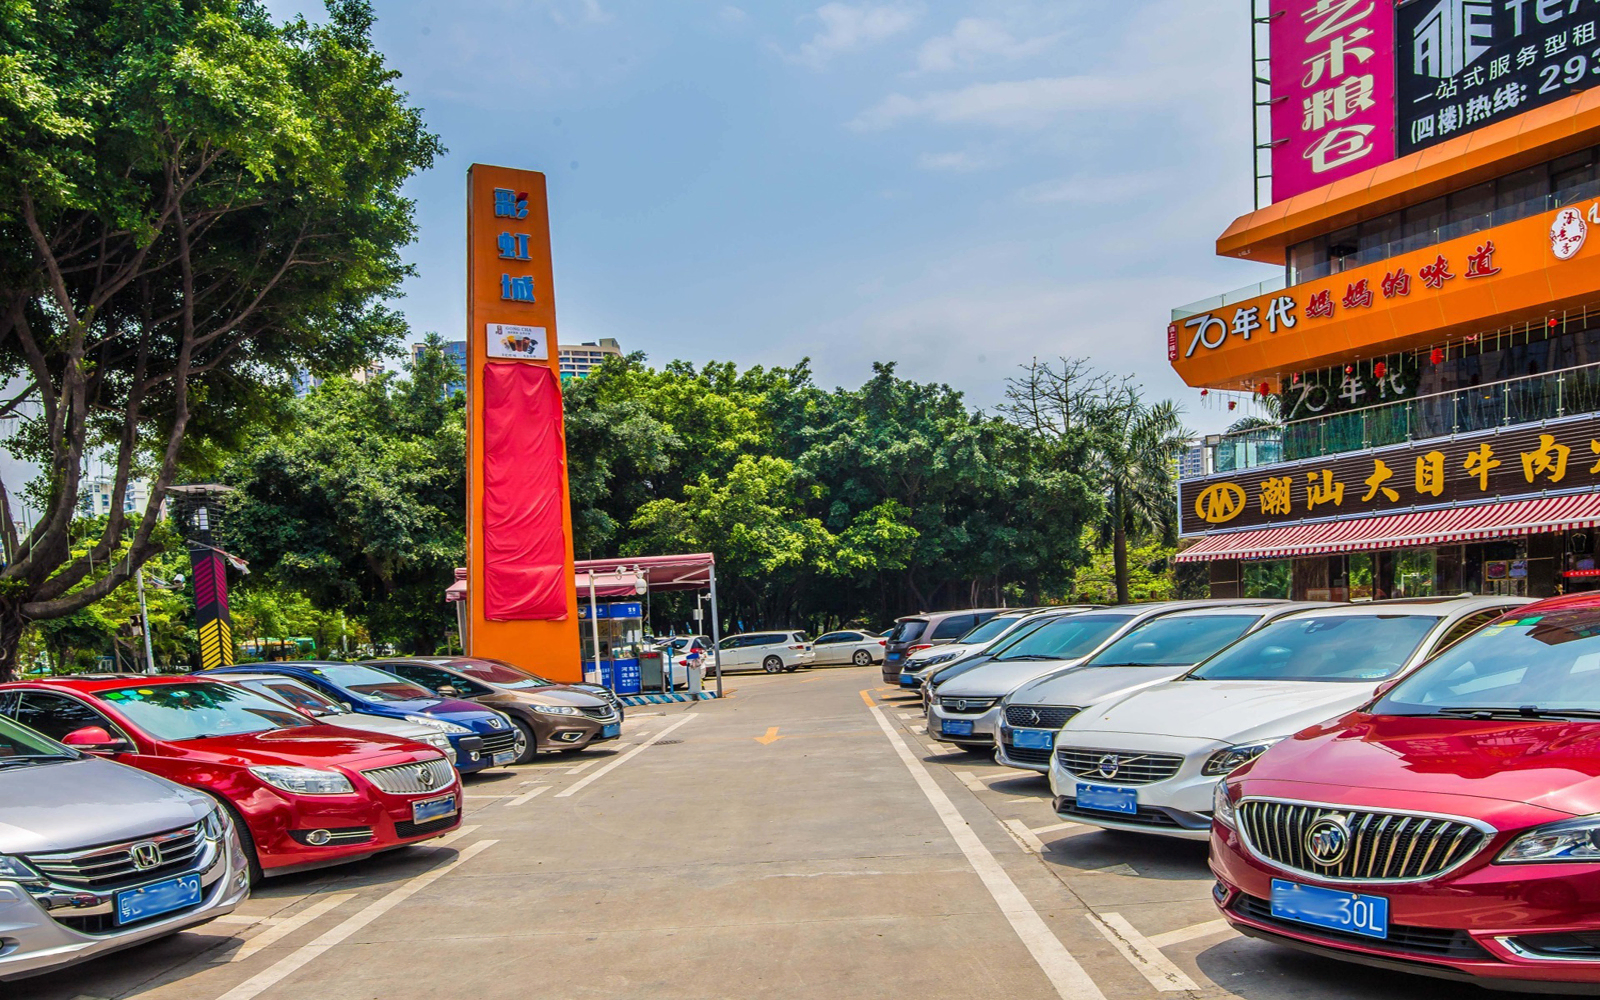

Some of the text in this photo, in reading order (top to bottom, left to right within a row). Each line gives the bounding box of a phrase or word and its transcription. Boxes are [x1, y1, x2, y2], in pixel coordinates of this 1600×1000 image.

[1301, 0, 1376, 174] 艺术粮仓
[1413, 20, 1597, 103] 一站式服务型租
[494, 187, 536, 303] 彩虹城
[1184, 240, 1502, 357] 70年代 媽媽的味道
